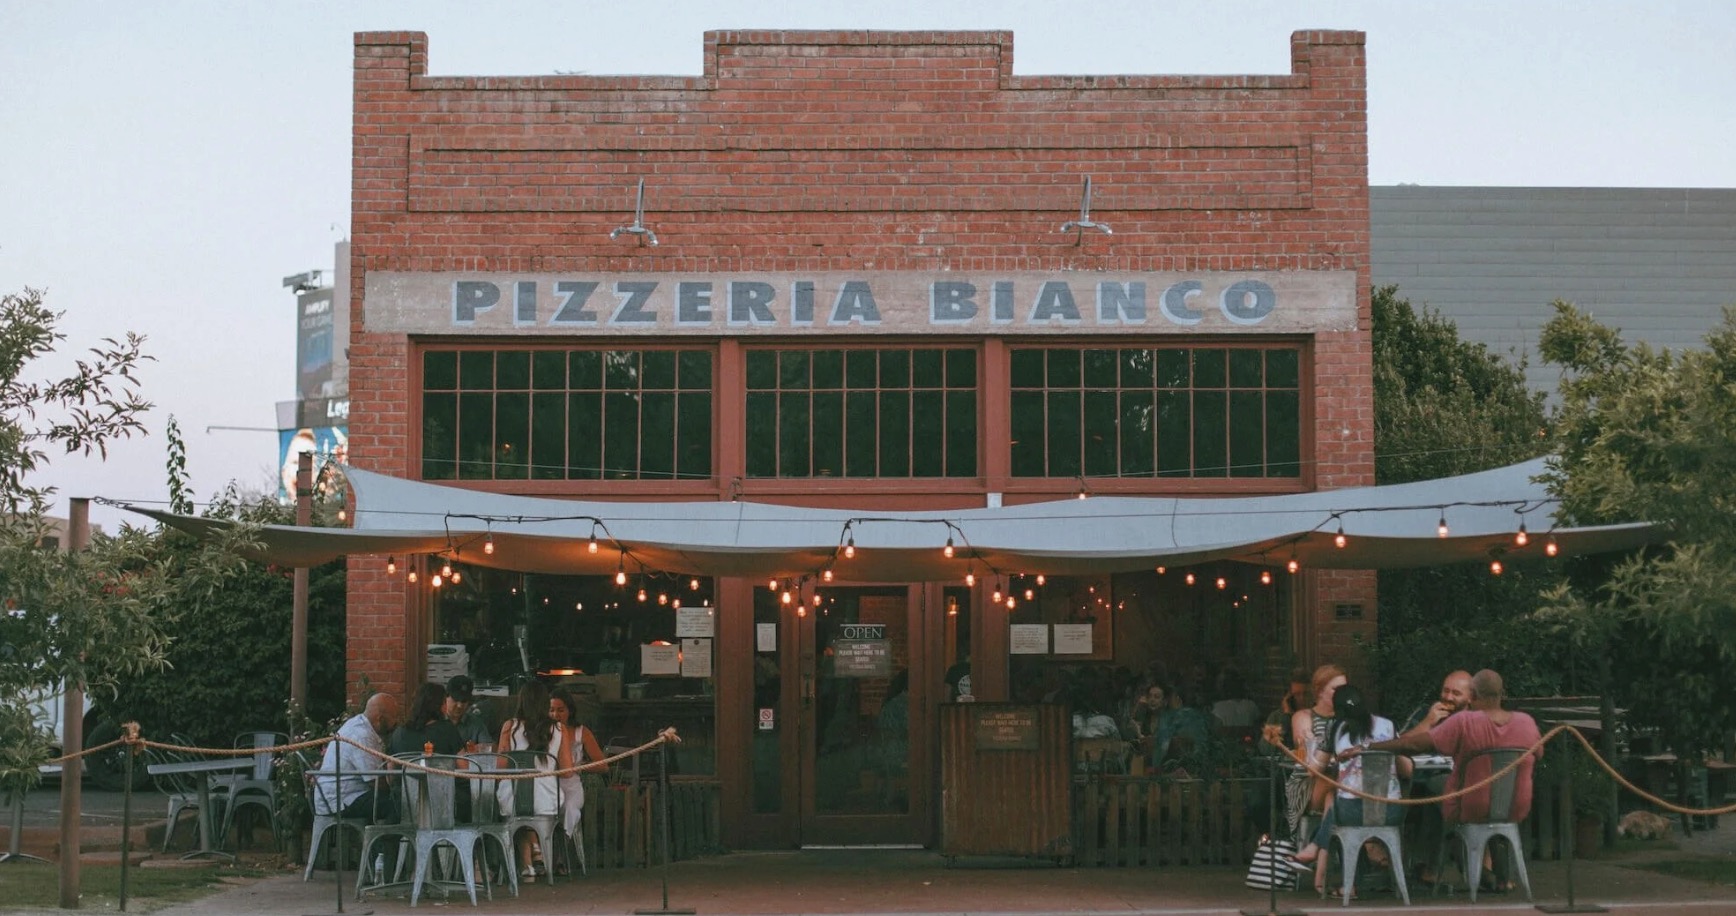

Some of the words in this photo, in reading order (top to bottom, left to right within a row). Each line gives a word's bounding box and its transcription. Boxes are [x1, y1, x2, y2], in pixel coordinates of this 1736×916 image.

[450, 280, 882, 327] PIZZERIA
[928, 279, 1277, 325] BIANCO
[844, 627, 882, 638] OPEN
